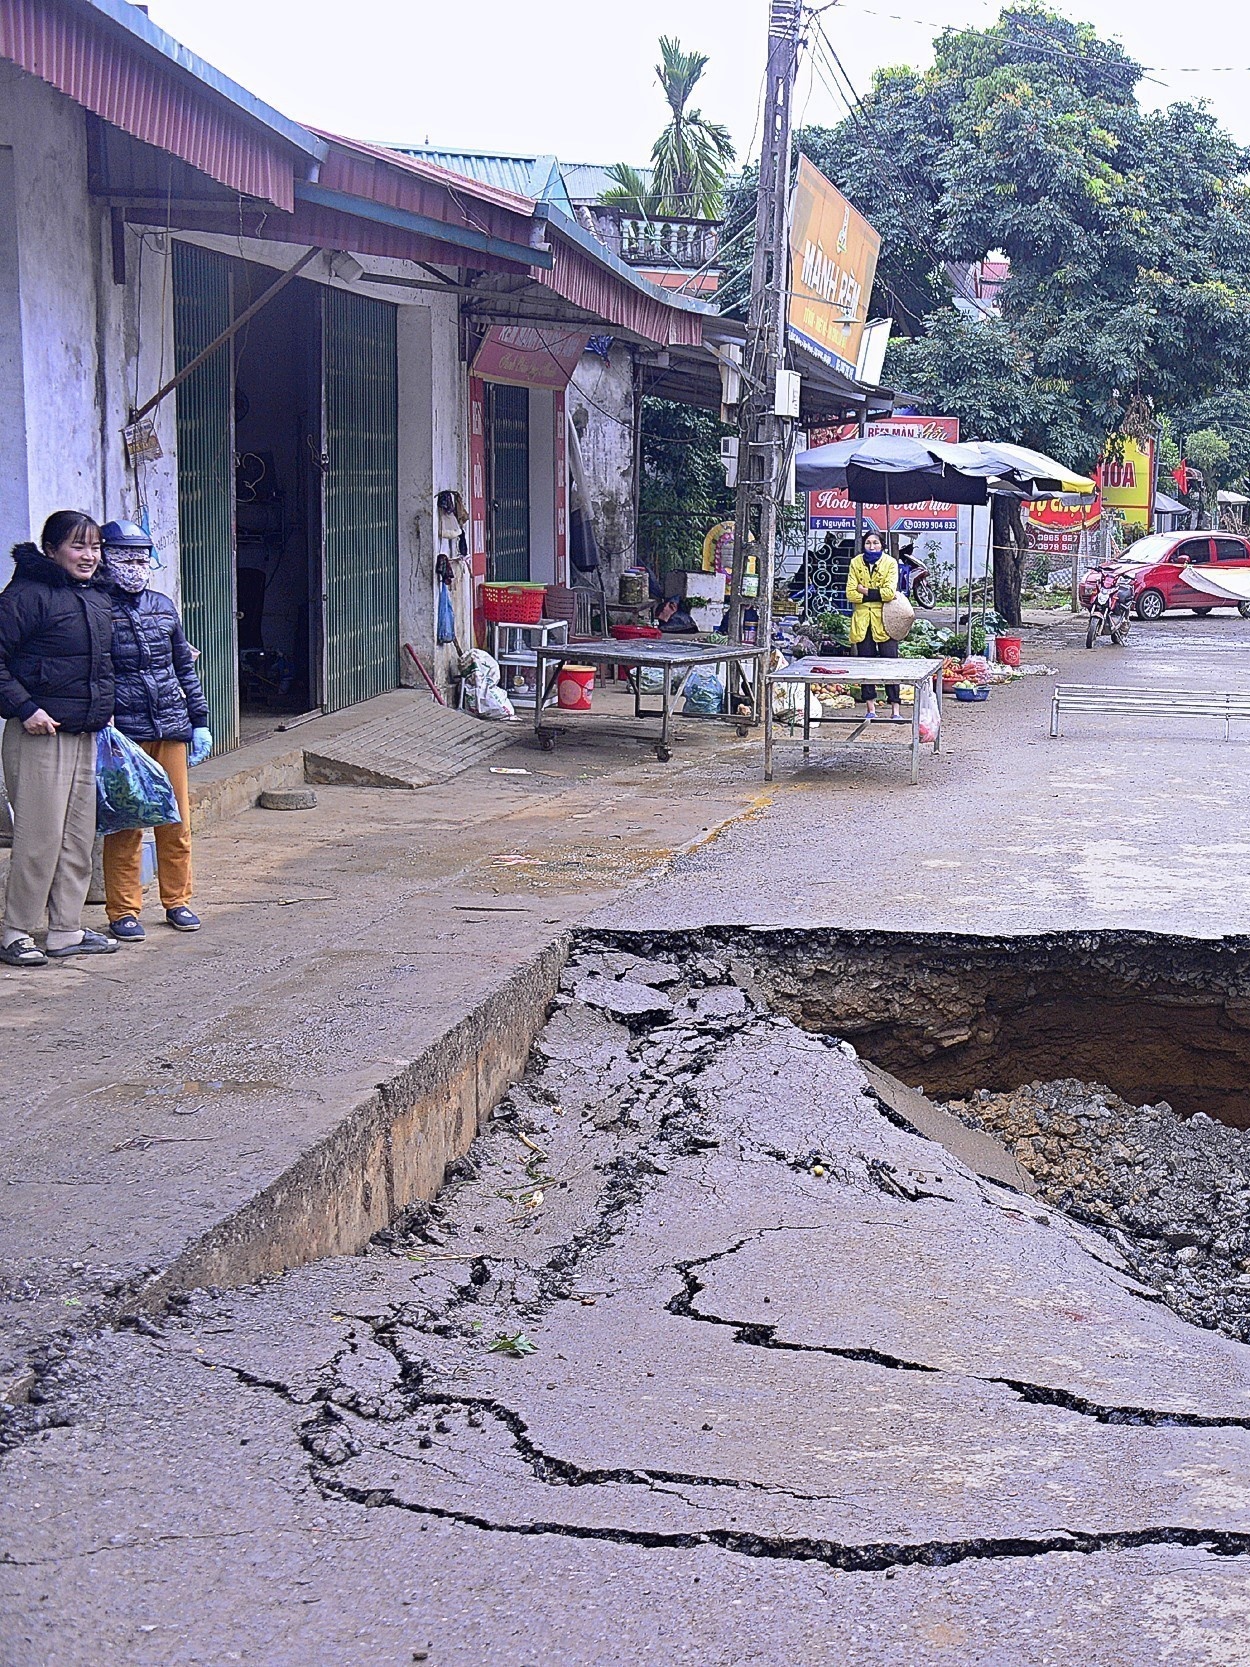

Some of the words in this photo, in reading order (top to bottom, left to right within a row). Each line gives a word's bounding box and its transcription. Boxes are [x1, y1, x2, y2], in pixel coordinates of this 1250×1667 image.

[801, 238, 840, 303] MÀNH
[837, 267, 862, 318] RÈM
[816, 491, 850, 509] Hoa
[913, 521, 930, 530] 0399
[930, 521, 943, 530] 904
